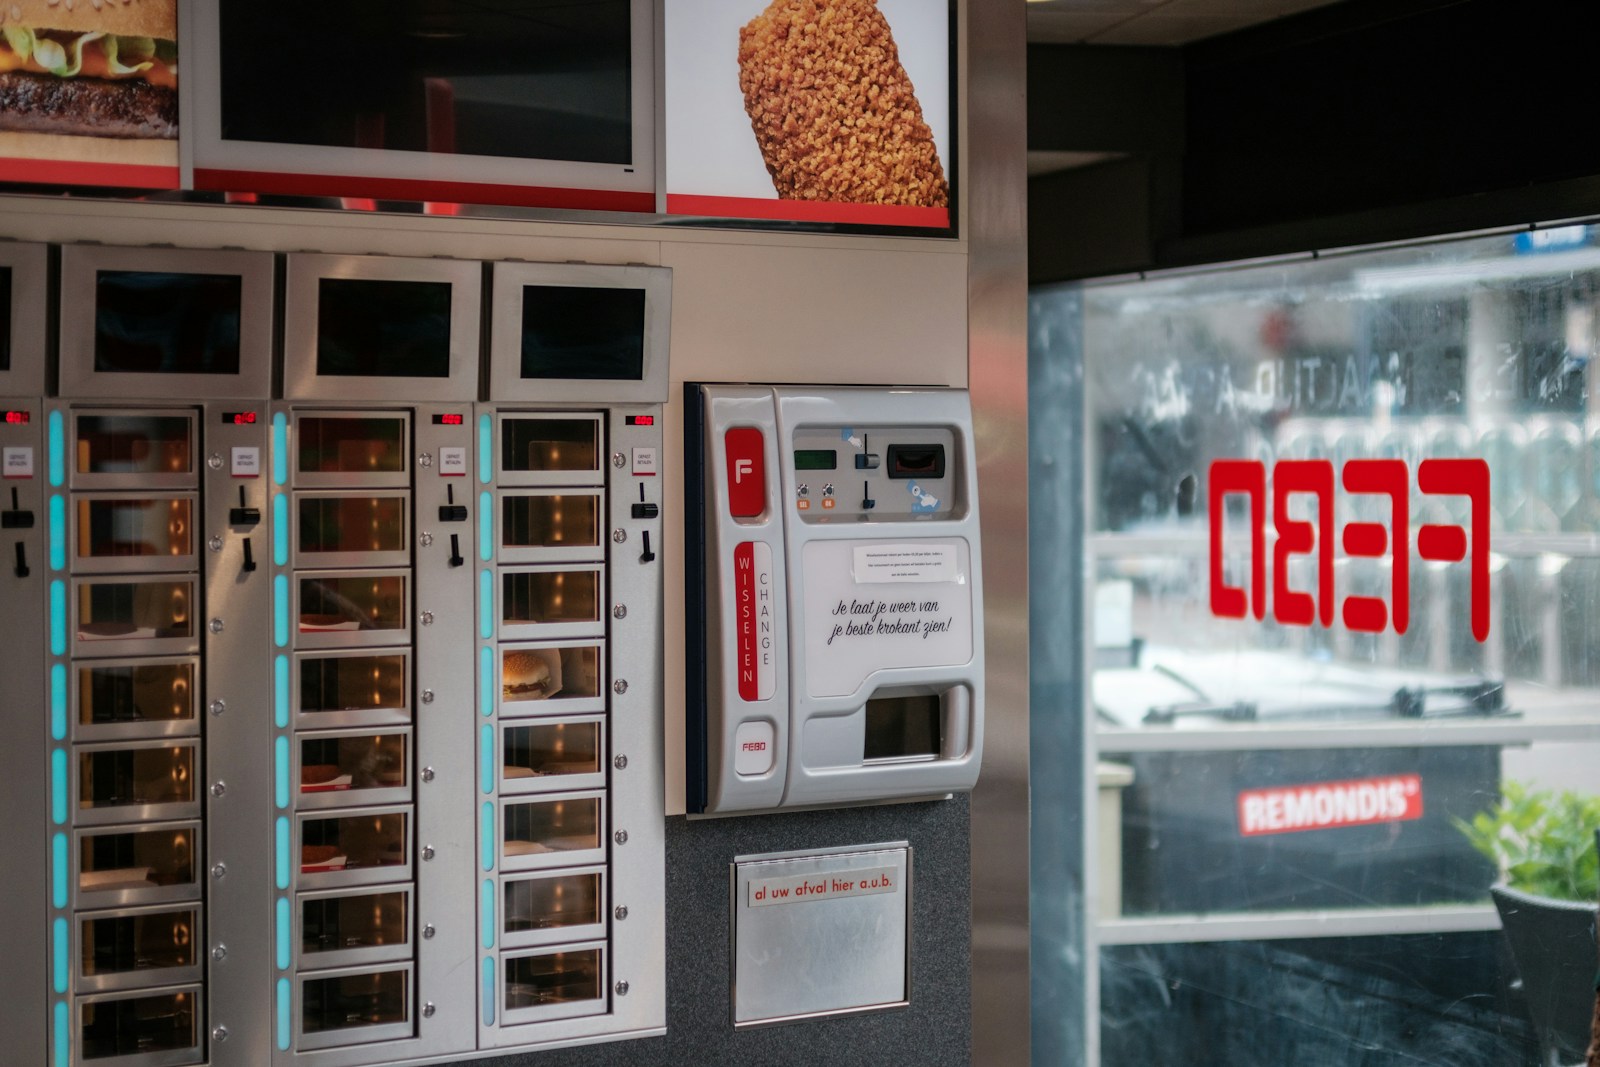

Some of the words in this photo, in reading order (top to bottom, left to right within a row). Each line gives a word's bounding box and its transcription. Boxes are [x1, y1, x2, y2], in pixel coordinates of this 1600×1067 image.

[735, 459, 753, 484] F
[739, 557, 753, 682] WISSELEN
[759, 572, 770, 665] CHANGE
[832, 600, 847, 616] Je
[850, 599, 875, 615] laat
[872, 601, 887, 622] je
[889, 601, 917, 614] weer
[919, 601, 939, 612] van
[827, 623, 843, 645] je
[846, 620, 874, 636] beste
[876, 618, 921, 634] krokant
[923, 616, 952, 639] zien!
[742, 742, 766, 752] FEBO
[755, 886, 766, 900] al
[771, 888, 789, 898] uw
[795, 880, 827, 896] afval
[832, 879, 854, 892] hier
[859, 874, 892, 889] a.u.b.
